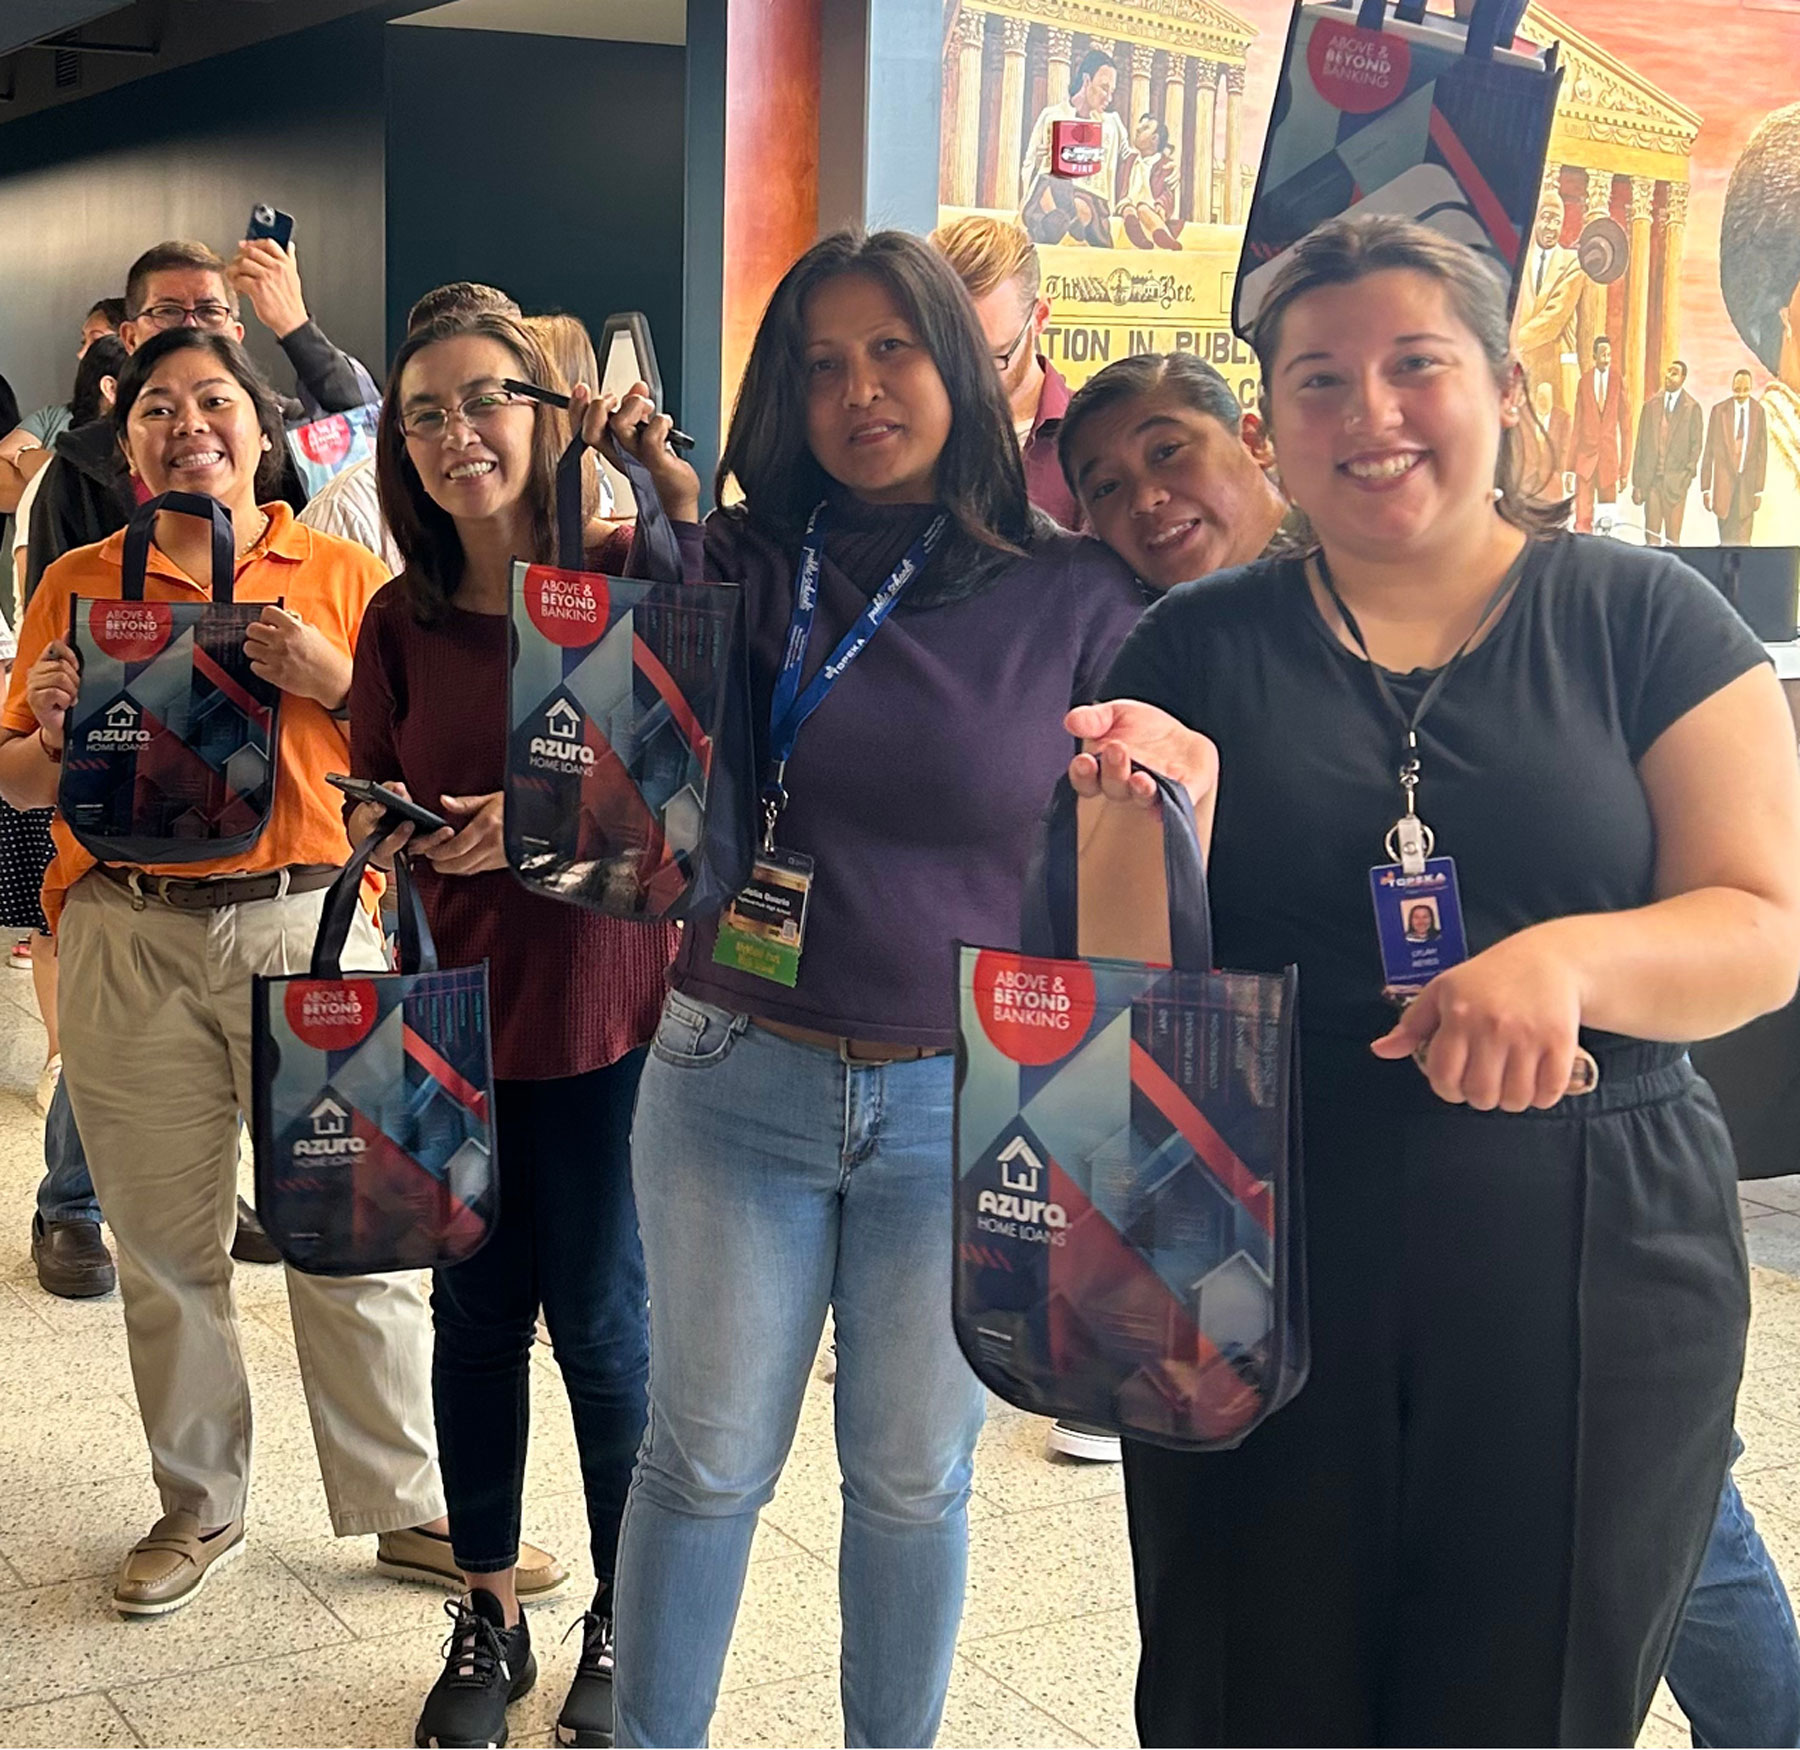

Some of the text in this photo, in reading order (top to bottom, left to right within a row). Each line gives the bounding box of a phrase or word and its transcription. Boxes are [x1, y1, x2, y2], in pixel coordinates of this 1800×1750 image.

[1328, 35, 1389, 58] ABOVE &
[1325, 47, 1391, 74] BEYOND
[1323, 60, 1389, 88] BANKING
[1046, 275, 1080, 300] The
[1035, 328, 1110, 361] TION
[1128, 330, 1153, 357] IN
[541, 580, 592, 595] ABOVE &
[541, 592, 597, 609] BEYOND
[106, 610, 154, 620] ABOVE &
[541, 605, 597, 623] BANKING
[105, 620, 158, 631] BEYOND
[105, 631, 158, 640] BANKING
[86, 743, 149, 751] HOME LOANS
[529, 755, 594, 777] HOME LOANS
[995, 971, 1066, 993] ABOVE &
[304, 990, 358, 1002] ABOVE &
[994, 988, 1070, 1011] BEYOND
[303, 1003, 361, 1014] BEYOND
[993, 1005, 1070, 1030] BANKING
[303, 1015, 361, 1026] BANKING
[977, 1216, 1067, 1248] HOME LOANS
